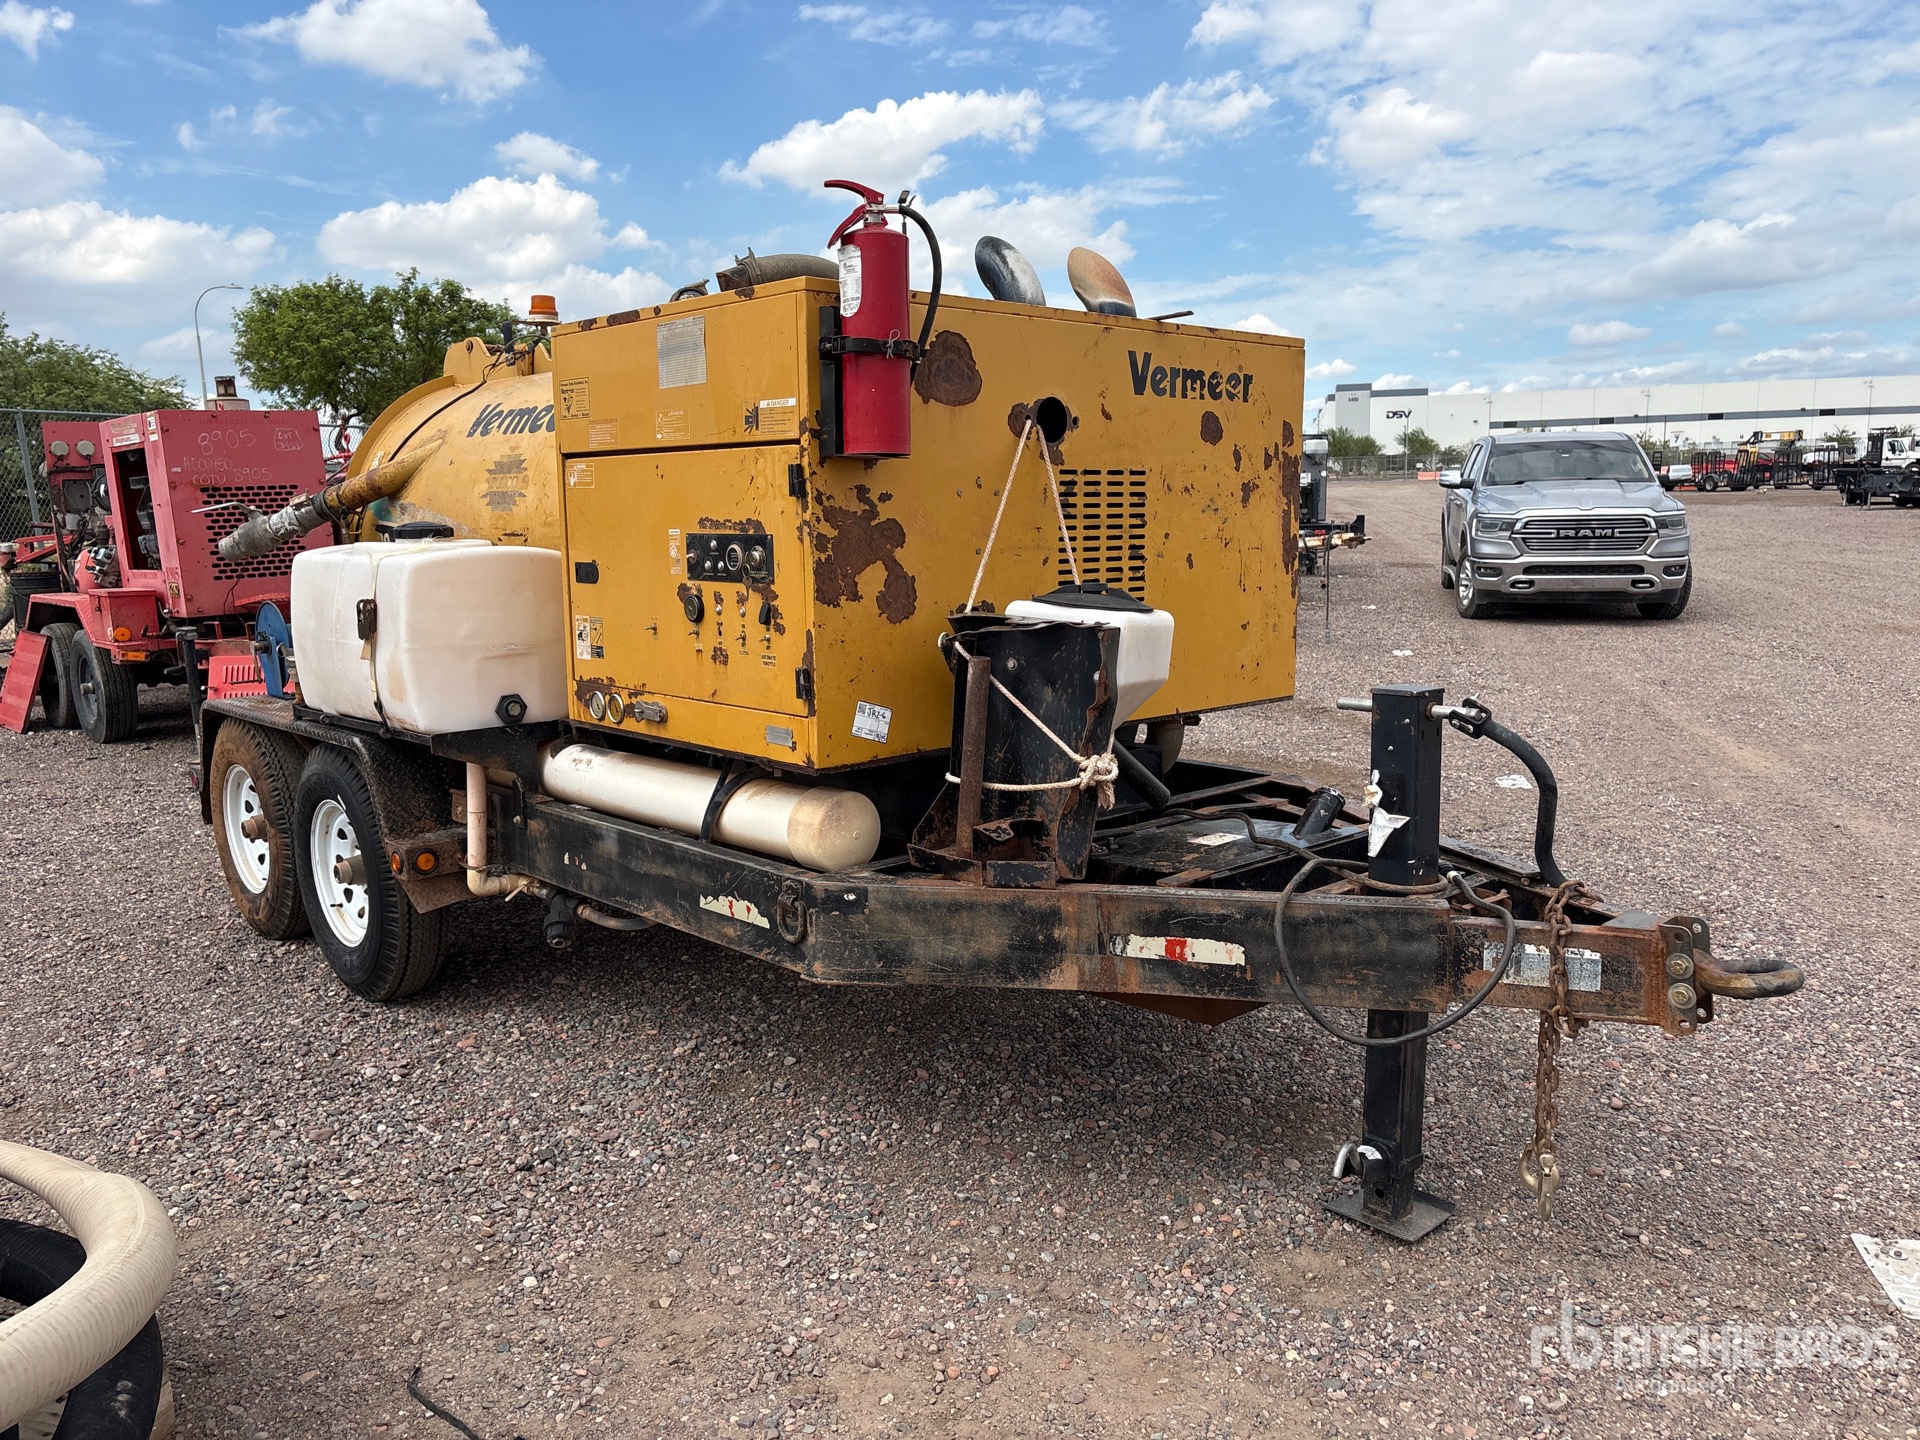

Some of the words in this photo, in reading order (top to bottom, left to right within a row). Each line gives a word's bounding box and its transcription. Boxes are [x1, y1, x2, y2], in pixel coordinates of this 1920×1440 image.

[1127, 350, 1254, 403] Vermeer
[1386, 410, 1412, 419] DSV
[198, 429, 256, 456] 8905
[233, 467, 273, 483] 8905
[1559, 529, 1612, 537] RAM
